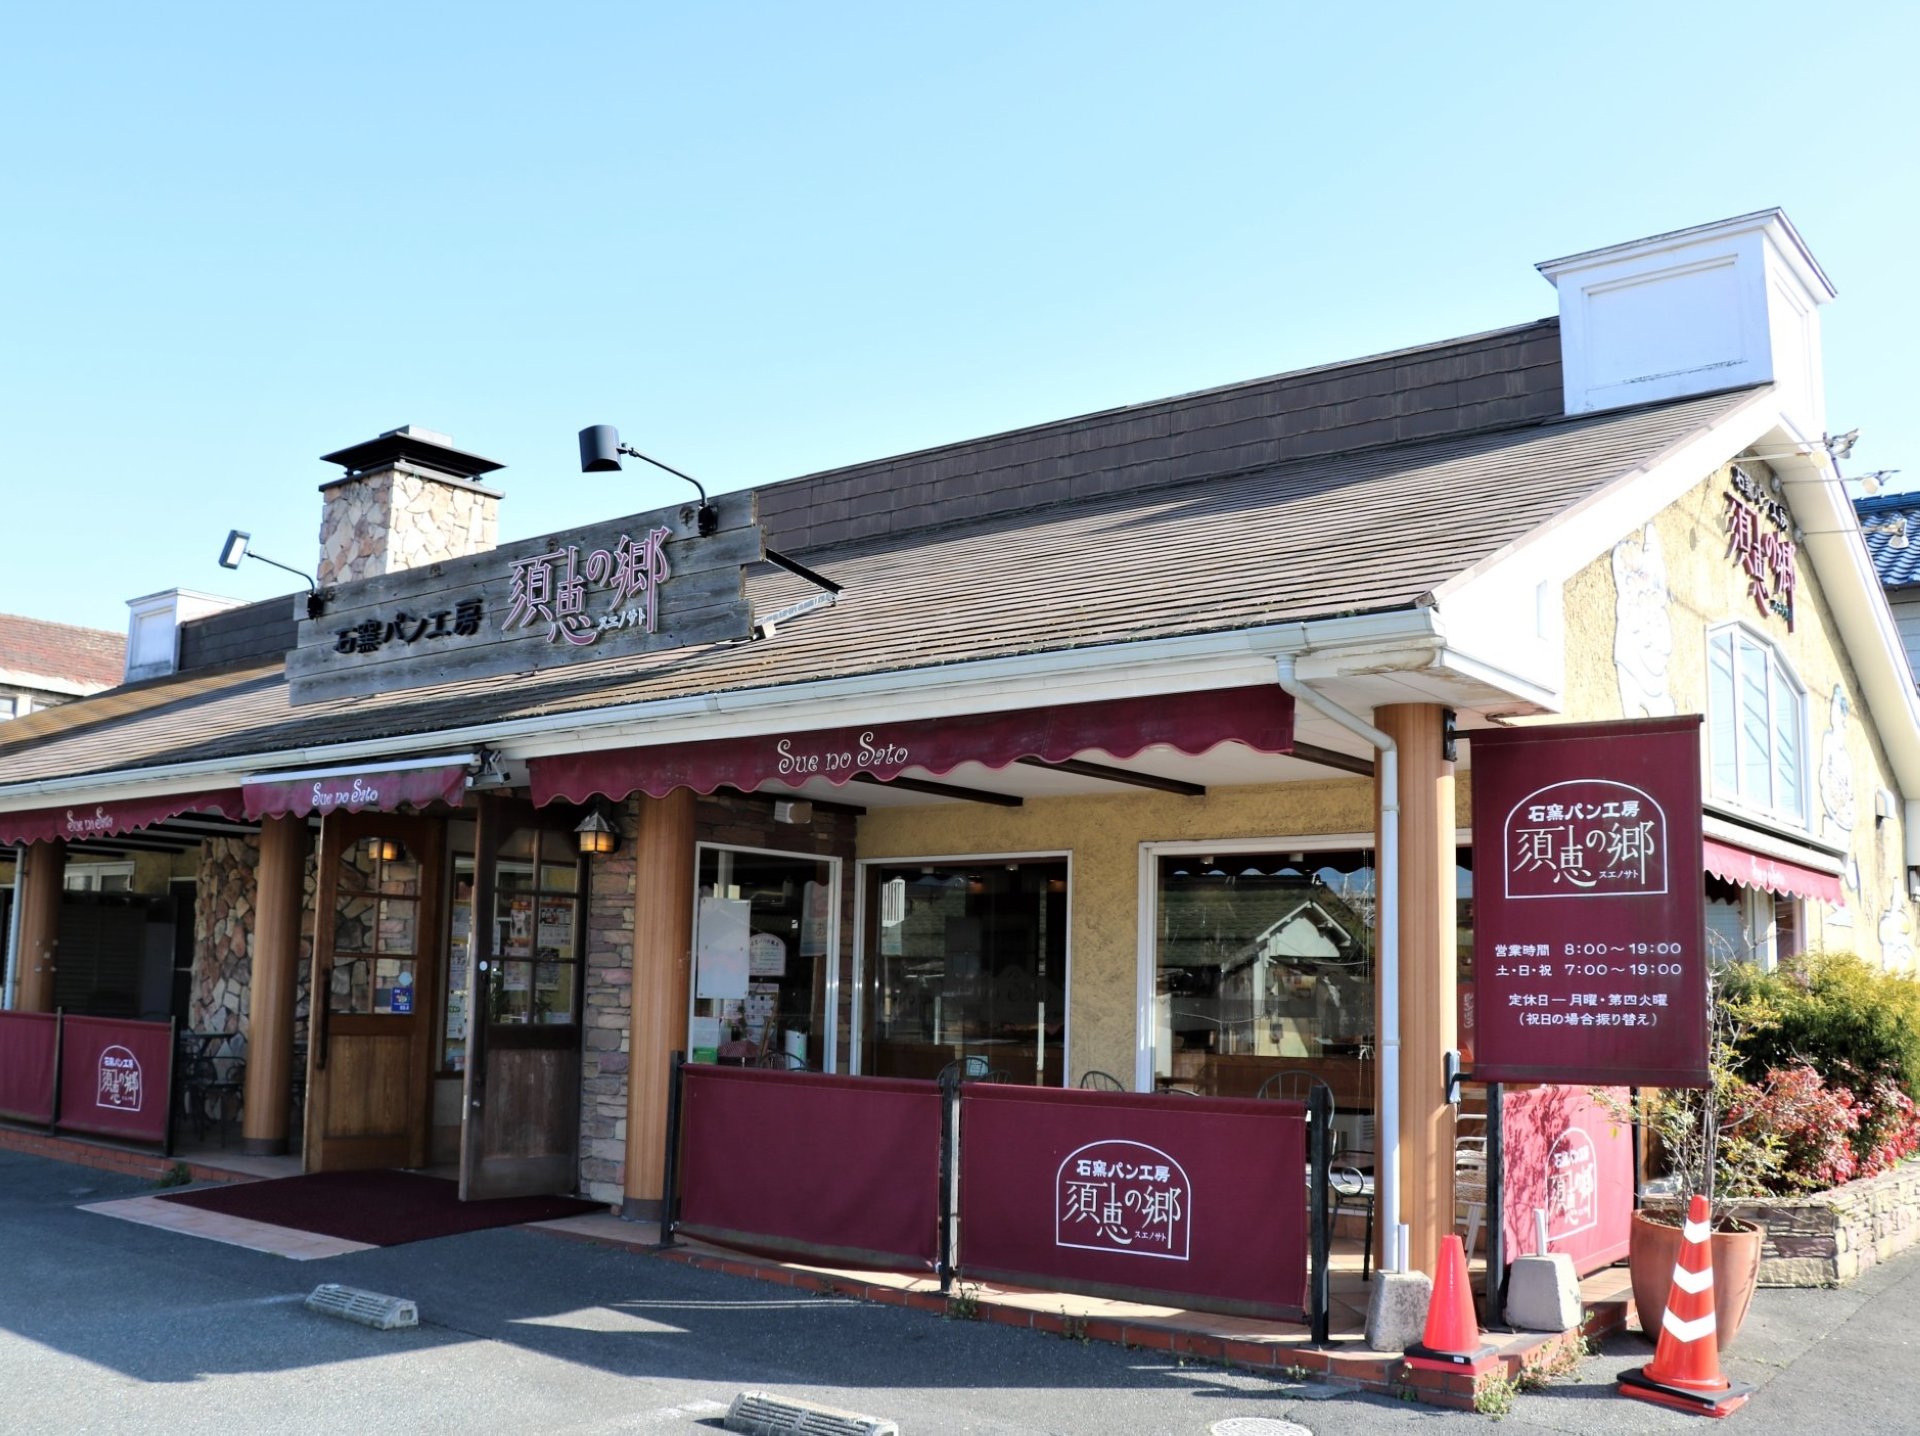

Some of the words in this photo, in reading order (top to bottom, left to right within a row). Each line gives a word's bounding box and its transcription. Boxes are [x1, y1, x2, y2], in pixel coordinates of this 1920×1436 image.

[501, 525, 673, 646] 須恵の郷
[333, 598, 483, 654] 石窯パン工房
[598, 607, 646, 630] スエノサト
[777, 739, 819, 774] Sue
[825, 751, 851, 771] no
[857, 731, 908, 767] Sato
[312, 782, 333, 806] Sue
[335, 791, 350, 804] no
[351, 778, 378, 803] Sato
[1528, 800, 1640, 822] 石窯パン工房
[1513, 820, 1655, 887] 須恵の郷
[1599, 870, 1638, 879] スエノサト
[1495, 944, 1550, 957] 営業時間
[1495, 964, 1552, 976] 土・日・祝
[1077, 1160, 1170, 1183] 石窯パン工房
[1062, 1181, 1181, 1249] 須恵の郷
[1134, 1231, 1166, 1241] スエノサト
